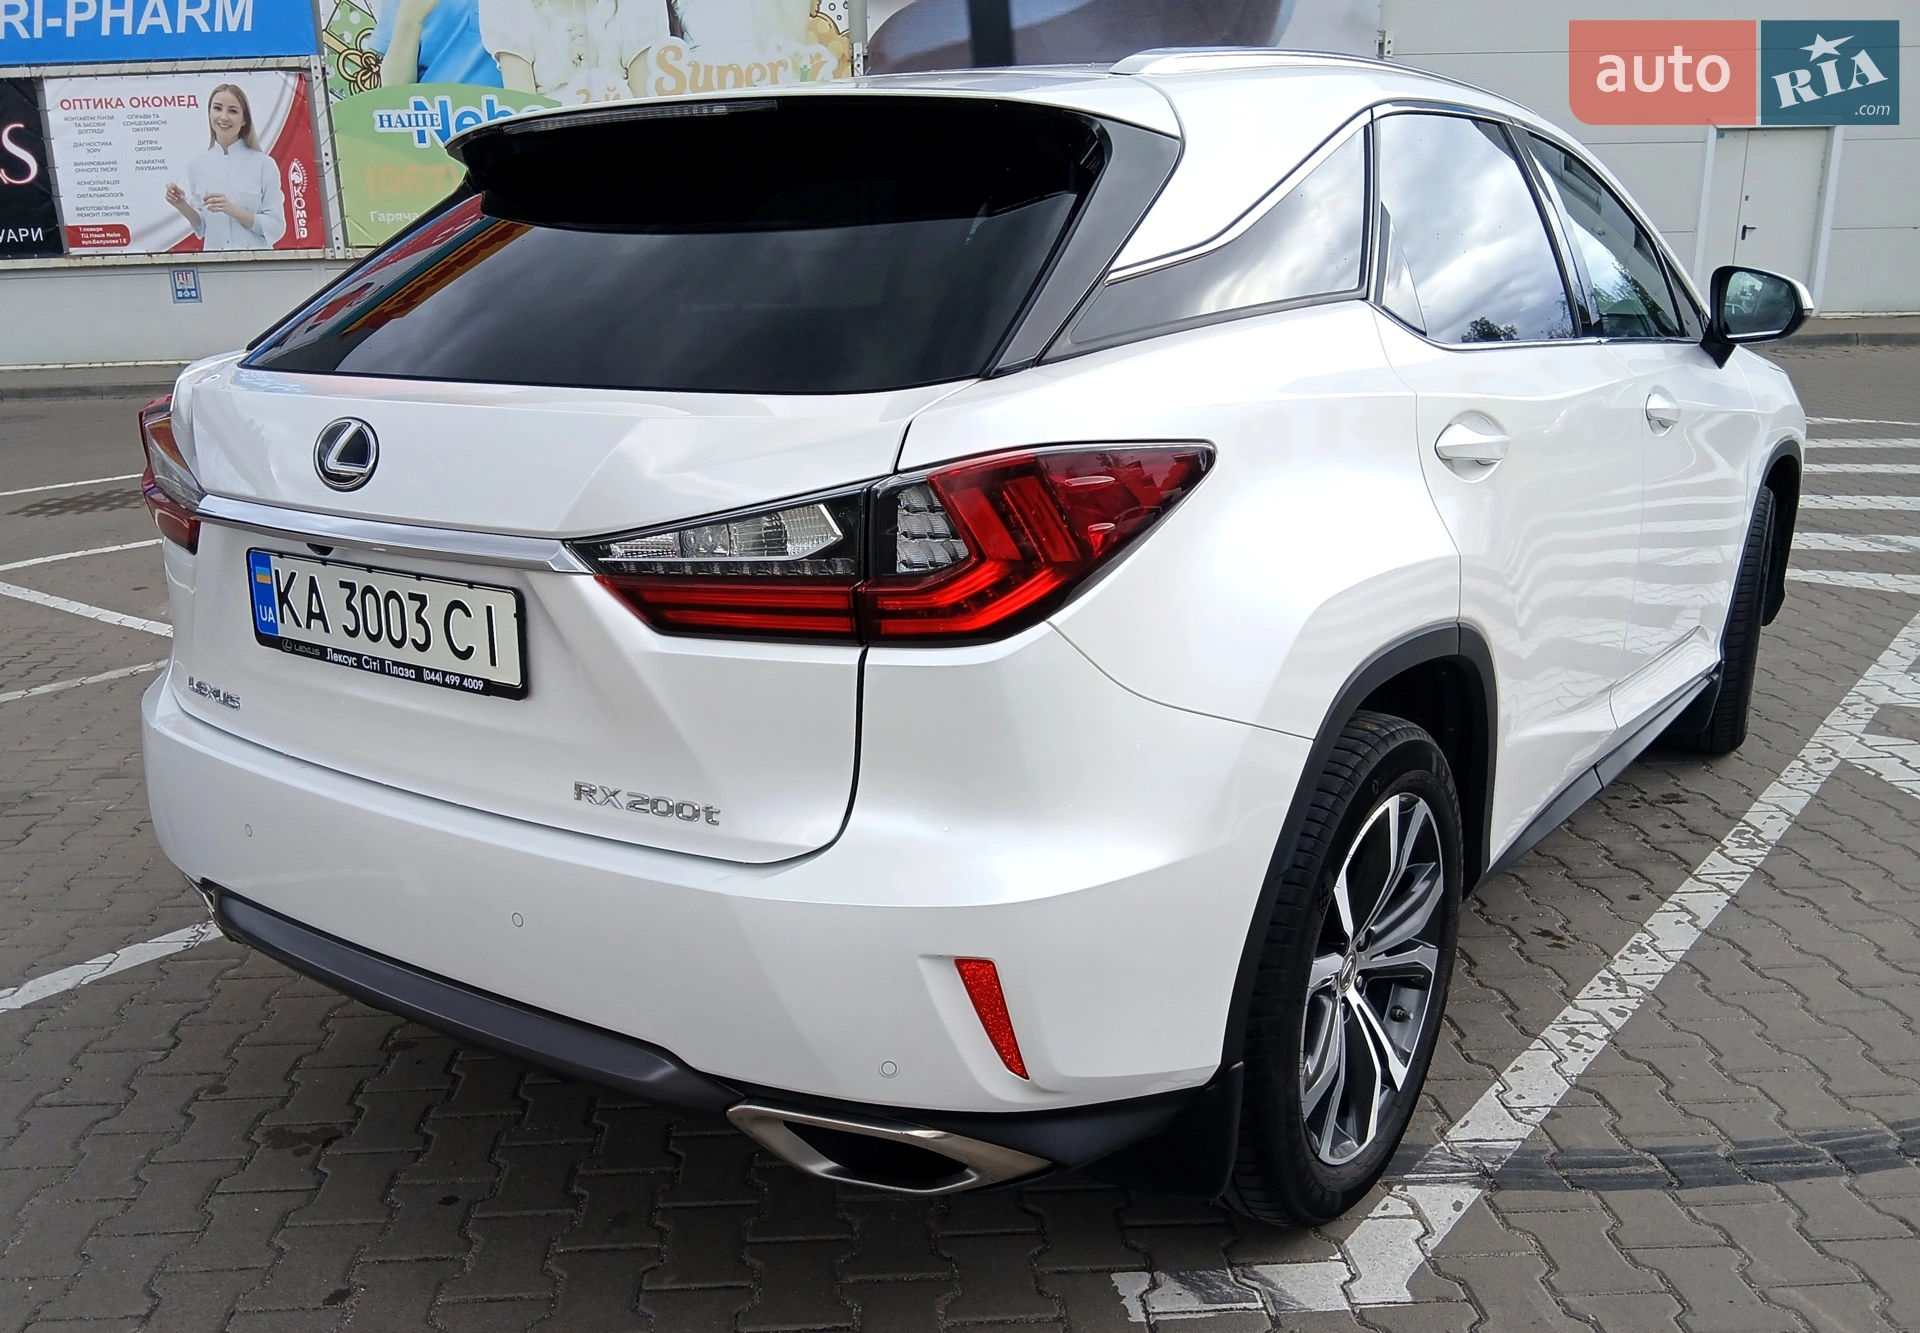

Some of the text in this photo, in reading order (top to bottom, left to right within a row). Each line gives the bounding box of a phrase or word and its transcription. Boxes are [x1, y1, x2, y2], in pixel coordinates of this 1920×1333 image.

[60, 94, 199, 111] ОПТИКА ОКОМЕД
[378, 112, 442, 128] НАШЕ
[258, 604, 276, 625] UA
[274, 567, 499, 668] KA 3003 CI
[326, 648, 358, 667] Лексус
[362, 656, 381, 672] Сіті
[385, 659, 416, 680] Плаза
[423, 669, 443, 685] (044)
[444, 672, 461, 687] 499
[462, 676, 484, 691] 4009
[188, 676, 241, 710] LEXUS
